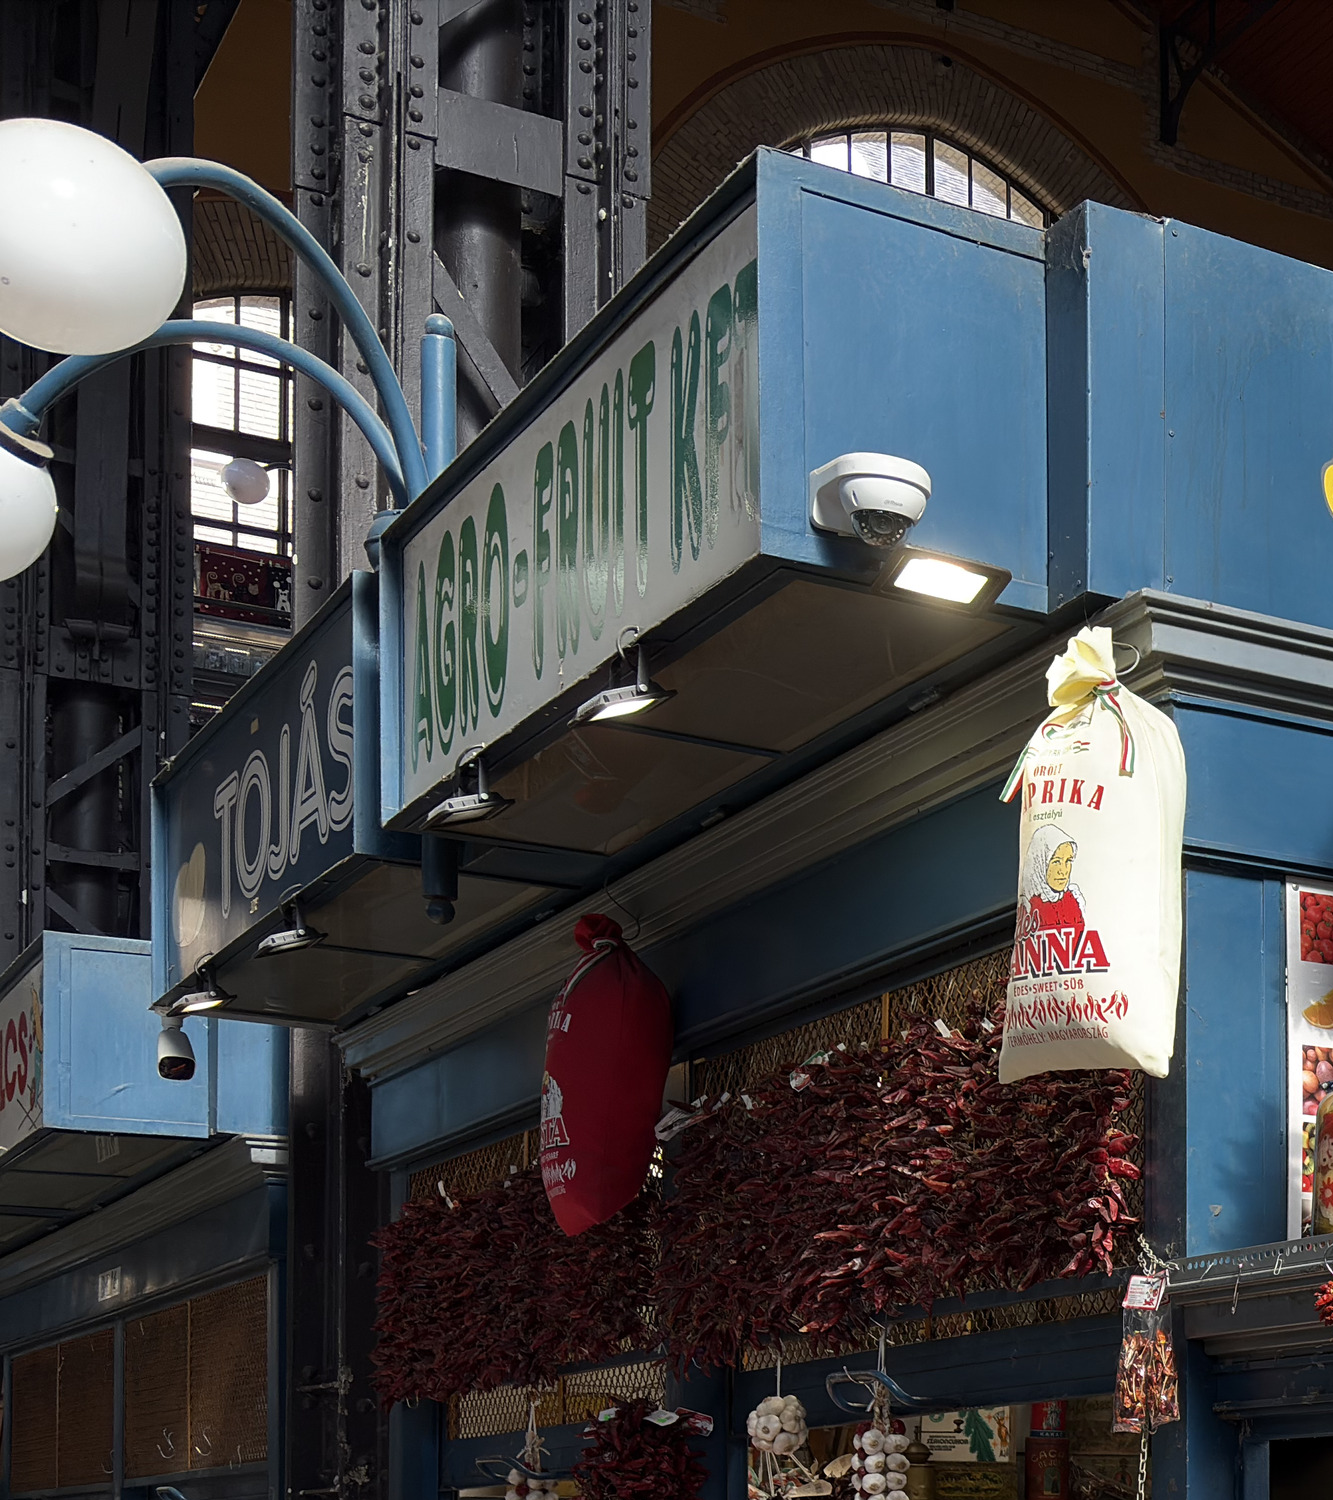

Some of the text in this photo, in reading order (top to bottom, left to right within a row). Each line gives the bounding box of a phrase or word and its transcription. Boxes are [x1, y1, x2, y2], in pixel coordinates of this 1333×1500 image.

[411, 339, 656, 774] AGRO-FRUIT
[213, 655, 354, 919] TOJÁS
[1023, 778, 1105, 814] PRIKA
[1015, 904, 1040, 941] des
[1011, 928, 1111, 982] ANNA
[1049, 1025, 1109, 1042] MAGYARORSZÁG
